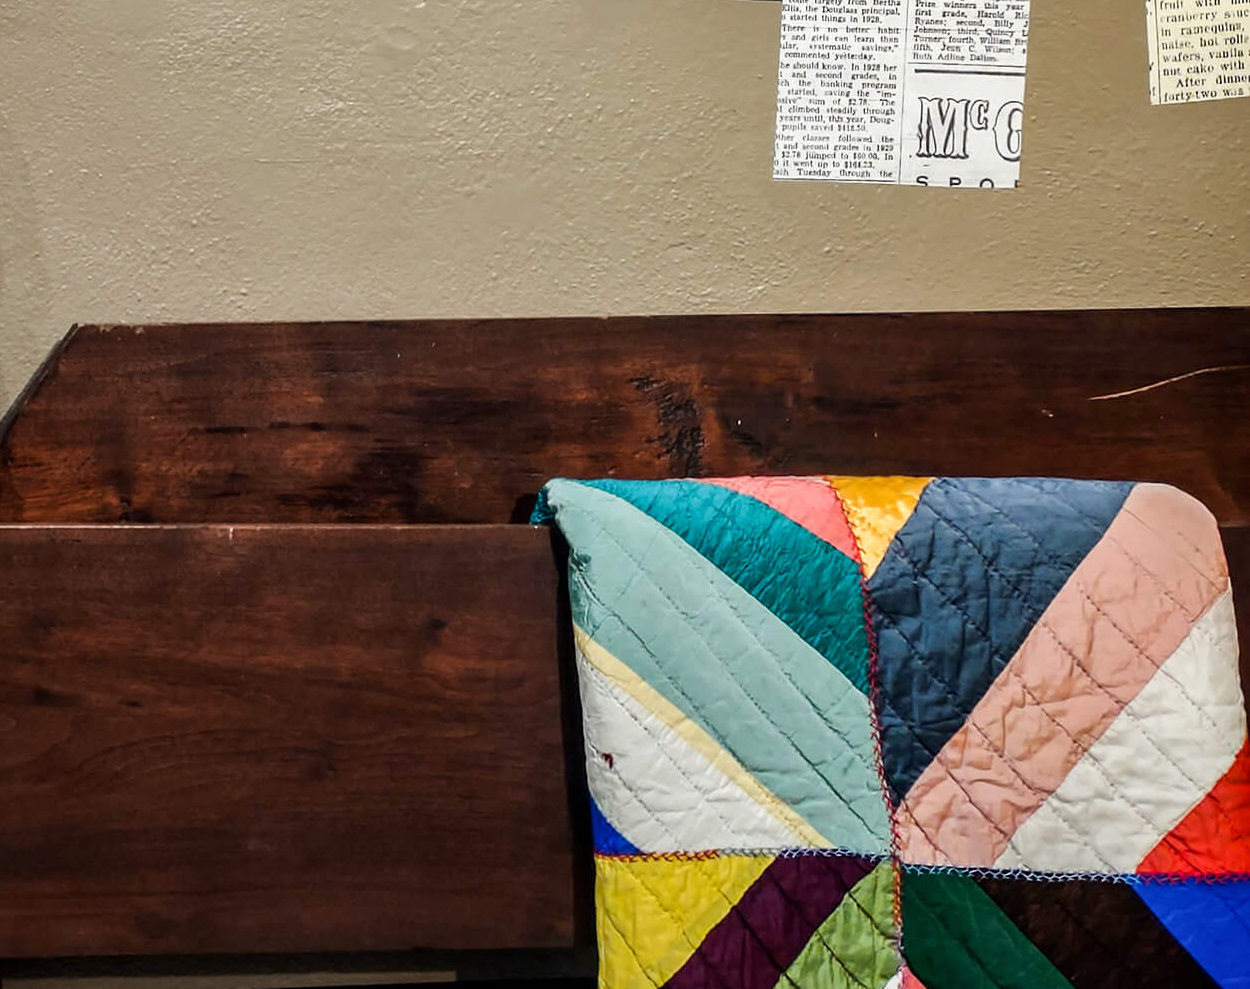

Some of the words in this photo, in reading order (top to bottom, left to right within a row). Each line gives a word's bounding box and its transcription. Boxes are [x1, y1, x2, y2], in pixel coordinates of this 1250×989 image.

[1160, 0, 1183, 10] fruit
[1161, 27, 1171, 37] in
[1187, 63, 1214, 74] cake
[1220, 60, 1245, 70] with
[1176, 77, 1207, 88] After
